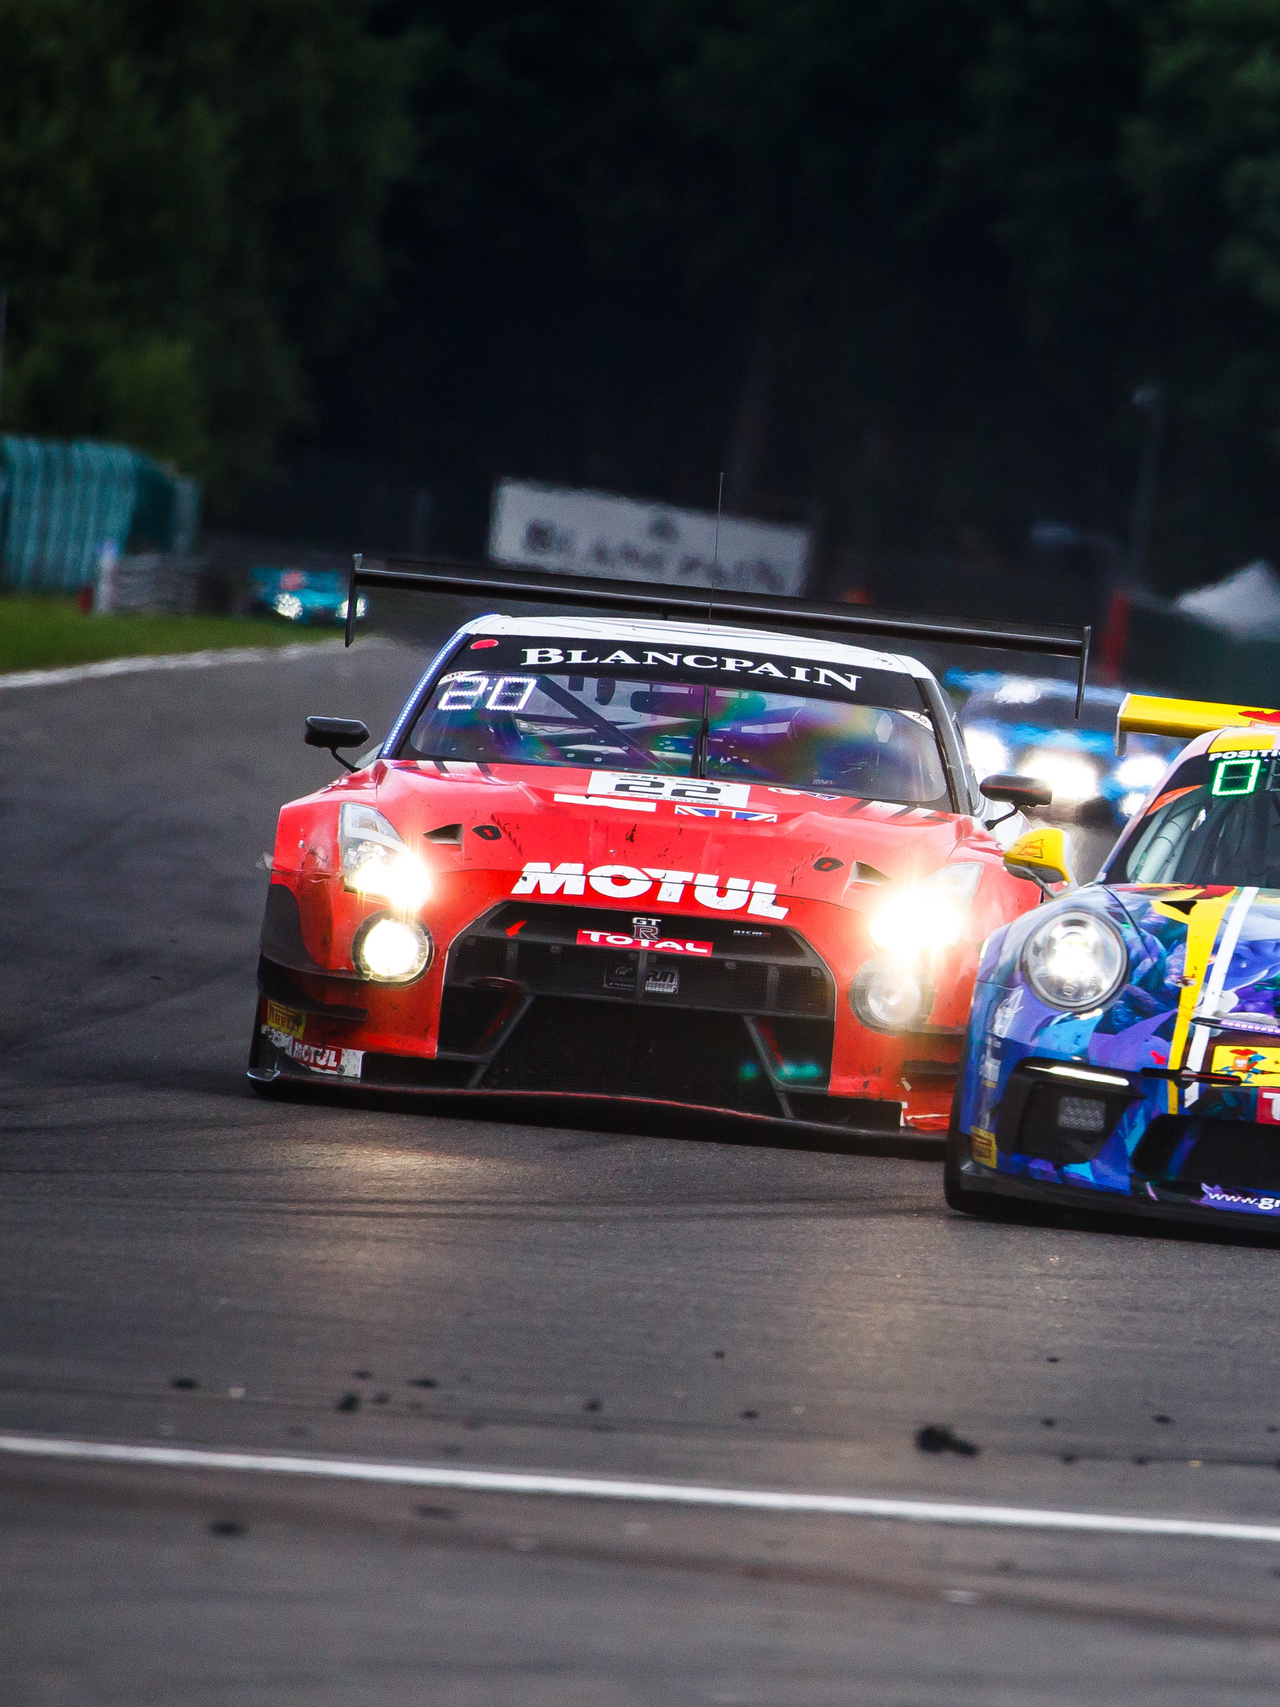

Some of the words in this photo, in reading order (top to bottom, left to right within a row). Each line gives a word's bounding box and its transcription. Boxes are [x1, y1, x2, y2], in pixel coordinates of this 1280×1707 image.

[520, 647, 863, 692] BLANCPAIN
[437, 676, 538, 711] 20
[614, 777, 722, 802] 22
[511, 861, 790, 921] MOTUL
[581, 930, 709, 954] TOTAL
